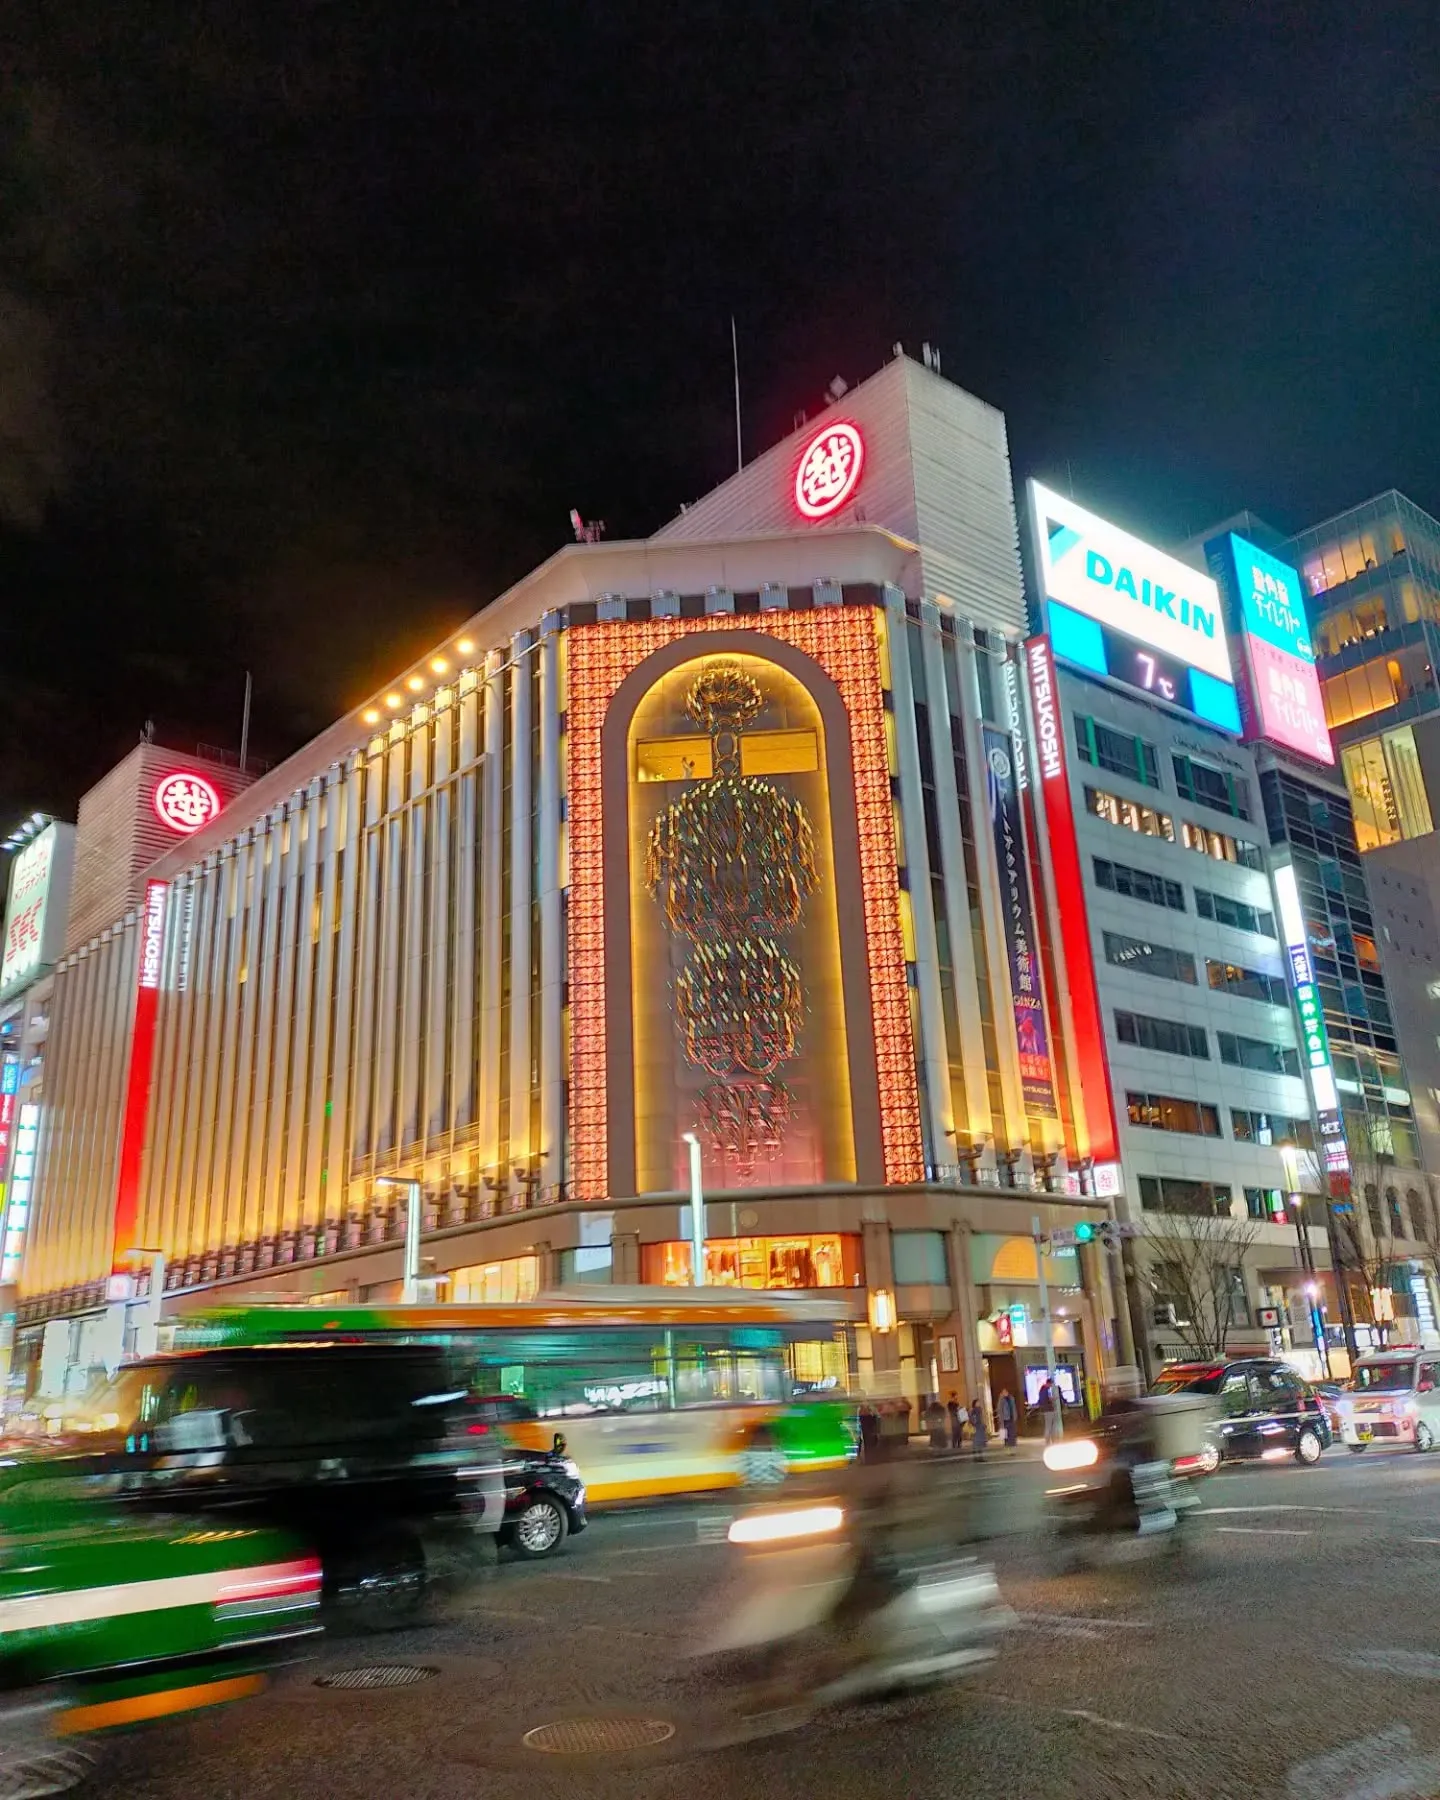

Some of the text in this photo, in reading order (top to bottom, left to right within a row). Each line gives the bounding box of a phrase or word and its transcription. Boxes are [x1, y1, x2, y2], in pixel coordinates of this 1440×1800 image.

[799, 432, 856, 508] 越
[1087, 550, 1214, 639] DAIKIN
[1031, 643, 1062, 779] MITSUKOSHI
[141, 885, 167, 989] MITSUKOSHI
[1013, 994, 1042, 1010] GINZA
